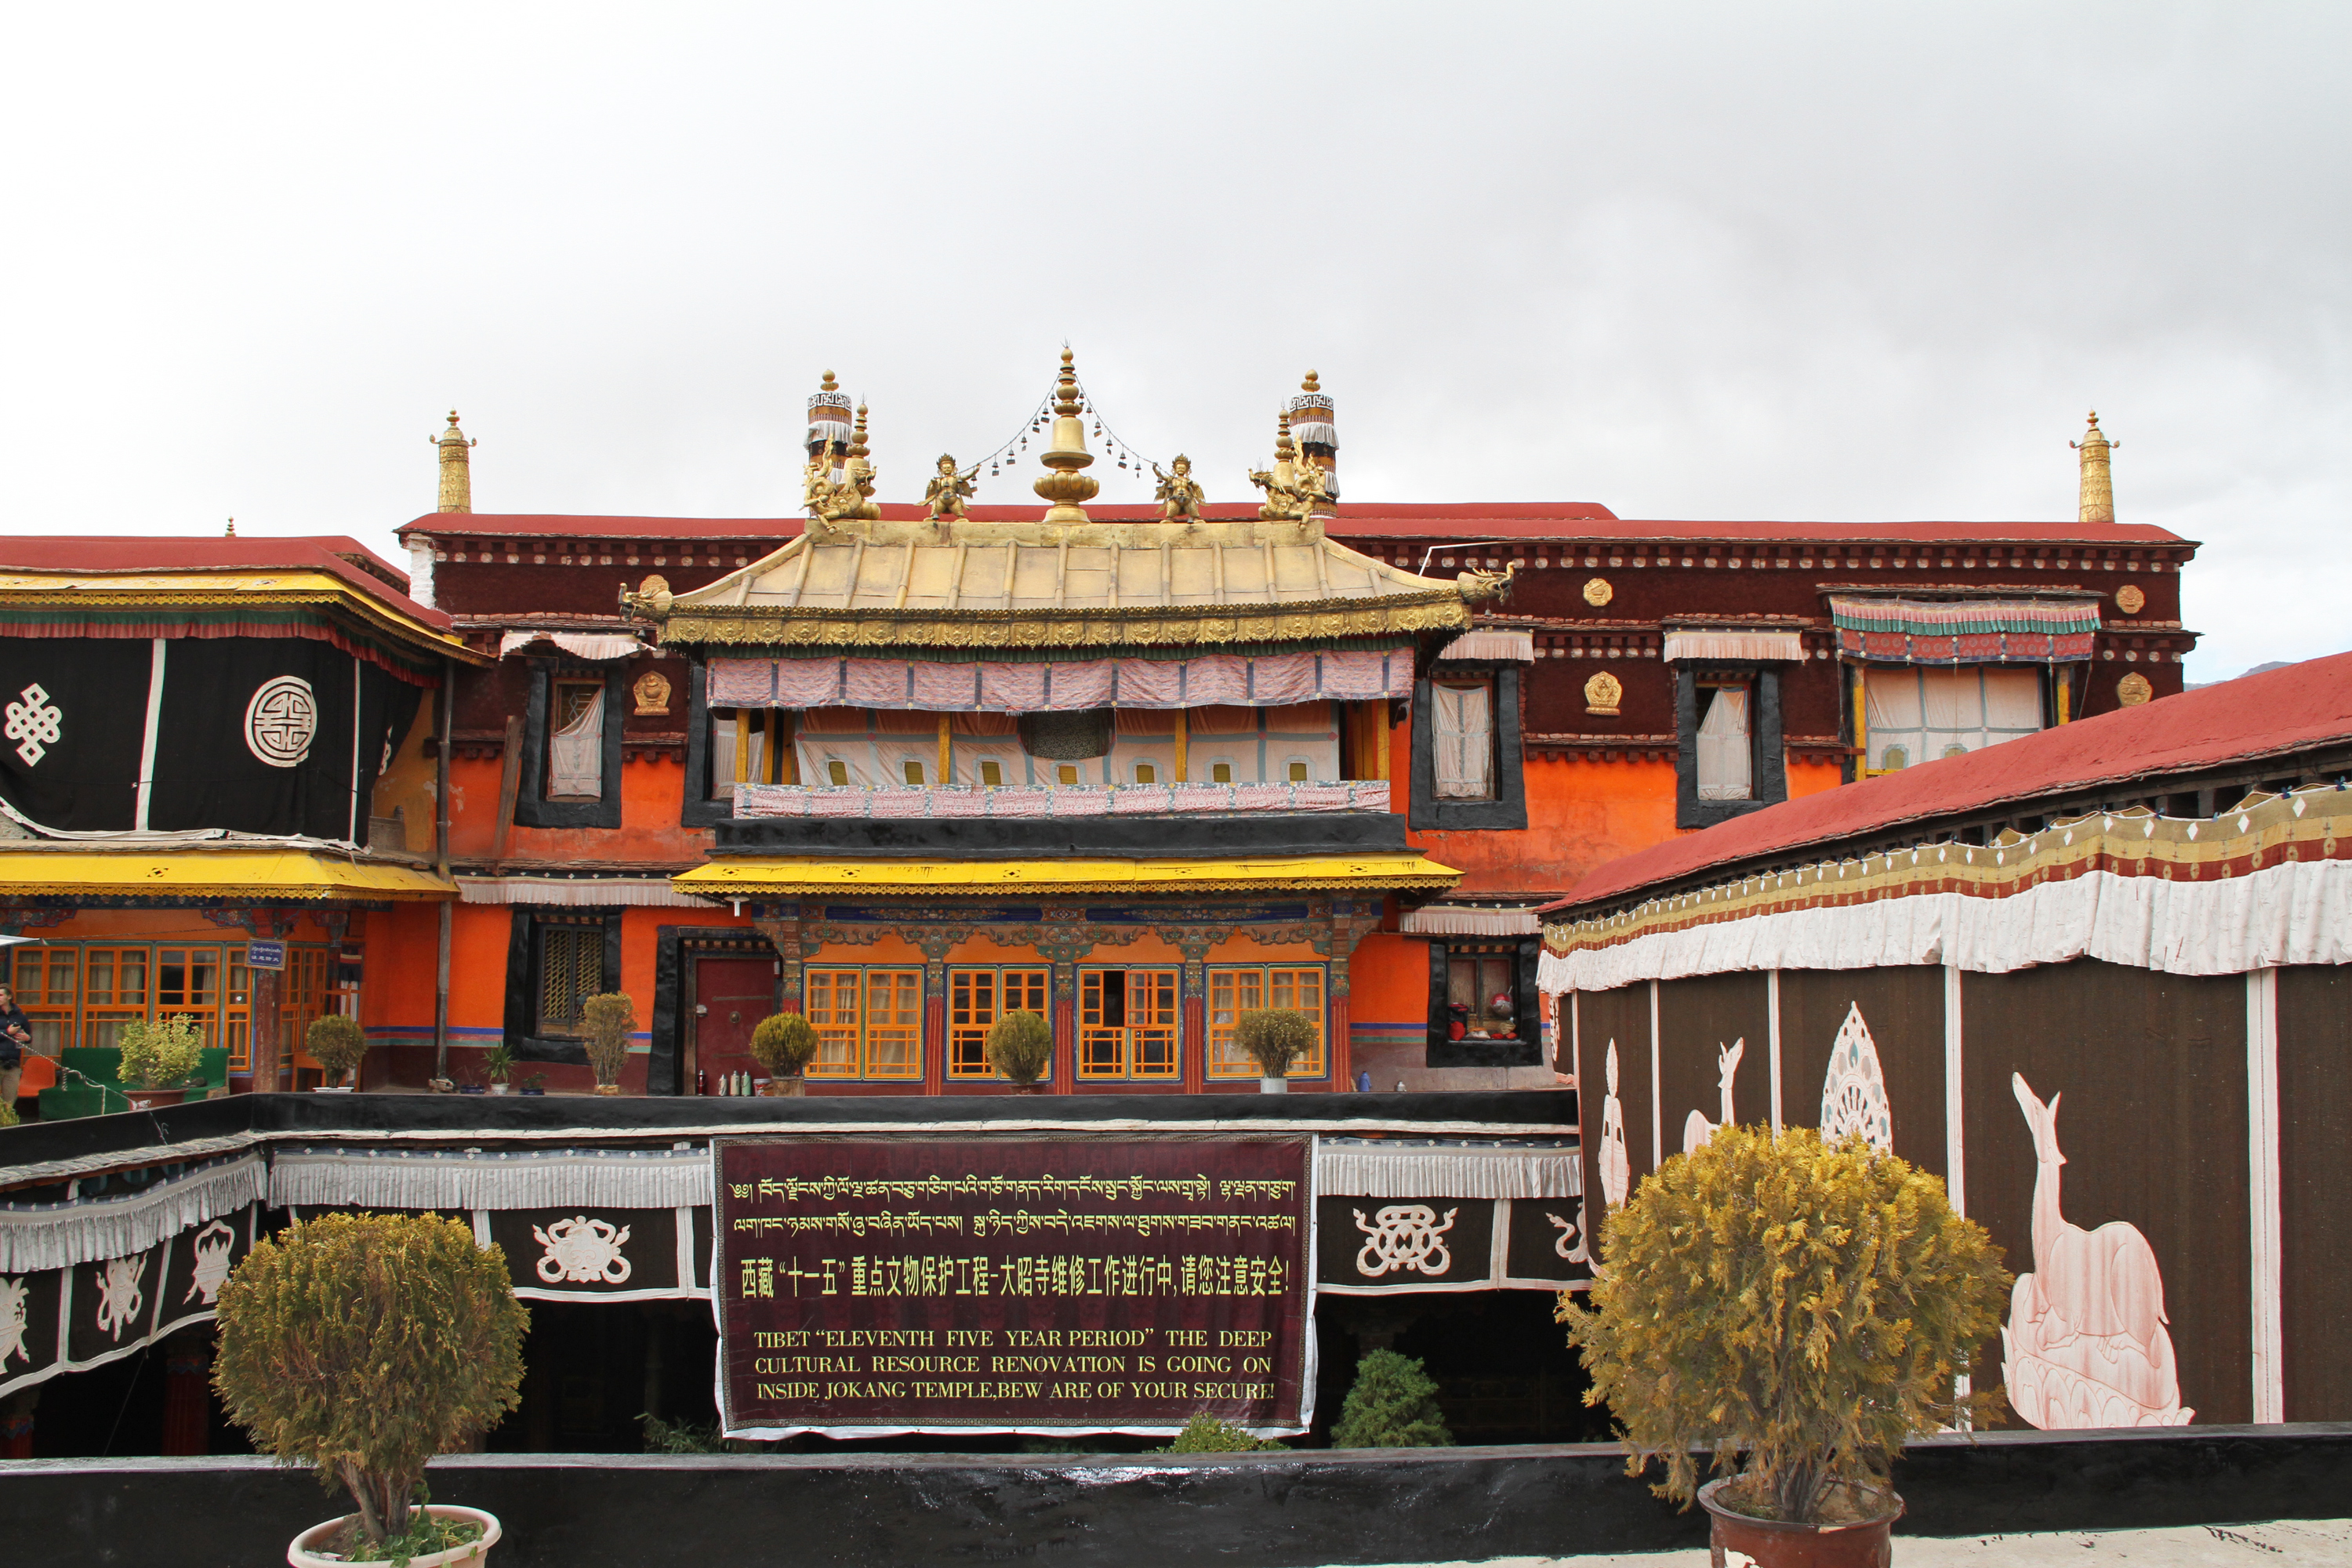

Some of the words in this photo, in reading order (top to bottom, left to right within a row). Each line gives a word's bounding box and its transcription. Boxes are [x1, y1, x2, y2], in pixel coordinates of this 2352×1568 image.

[753, 1330, 811, 1348] TIBET
[815, 1329, 935, 1347] “ELEVENTH
[946, 1330, 993, 1346] FIVE
[1004, 1330, 1063, 1346] YEAR
[1069, 1327, 1154, 1346] PERIOD”
[1165, 1330, 1207, 1346] THE
[1219, 1330, 1272, 1347] DEEP
[755, 1356, 861, 1374] CULTURAL
[872, 1356, 980, 1372] RESOURCE
[992, 1356, 1126, 1373] RENOVATION
[1138, 1356, 1156, 1372] IS
[1167, 1356, 1232, 1373] GOING
[1243, 1356, 1272, 1373] ON
[757, 1381, 819, 1399] INSIDE
[824, 1381, 906, 1400] JOKANG
[1049, 1382, 1092, 1398] ARE
[1097, 1382, 1125, 1398] OF
[1131, 1382, 1188, 1398] YOUR
[1193, 1382, 1275, 1399] SECURE!
